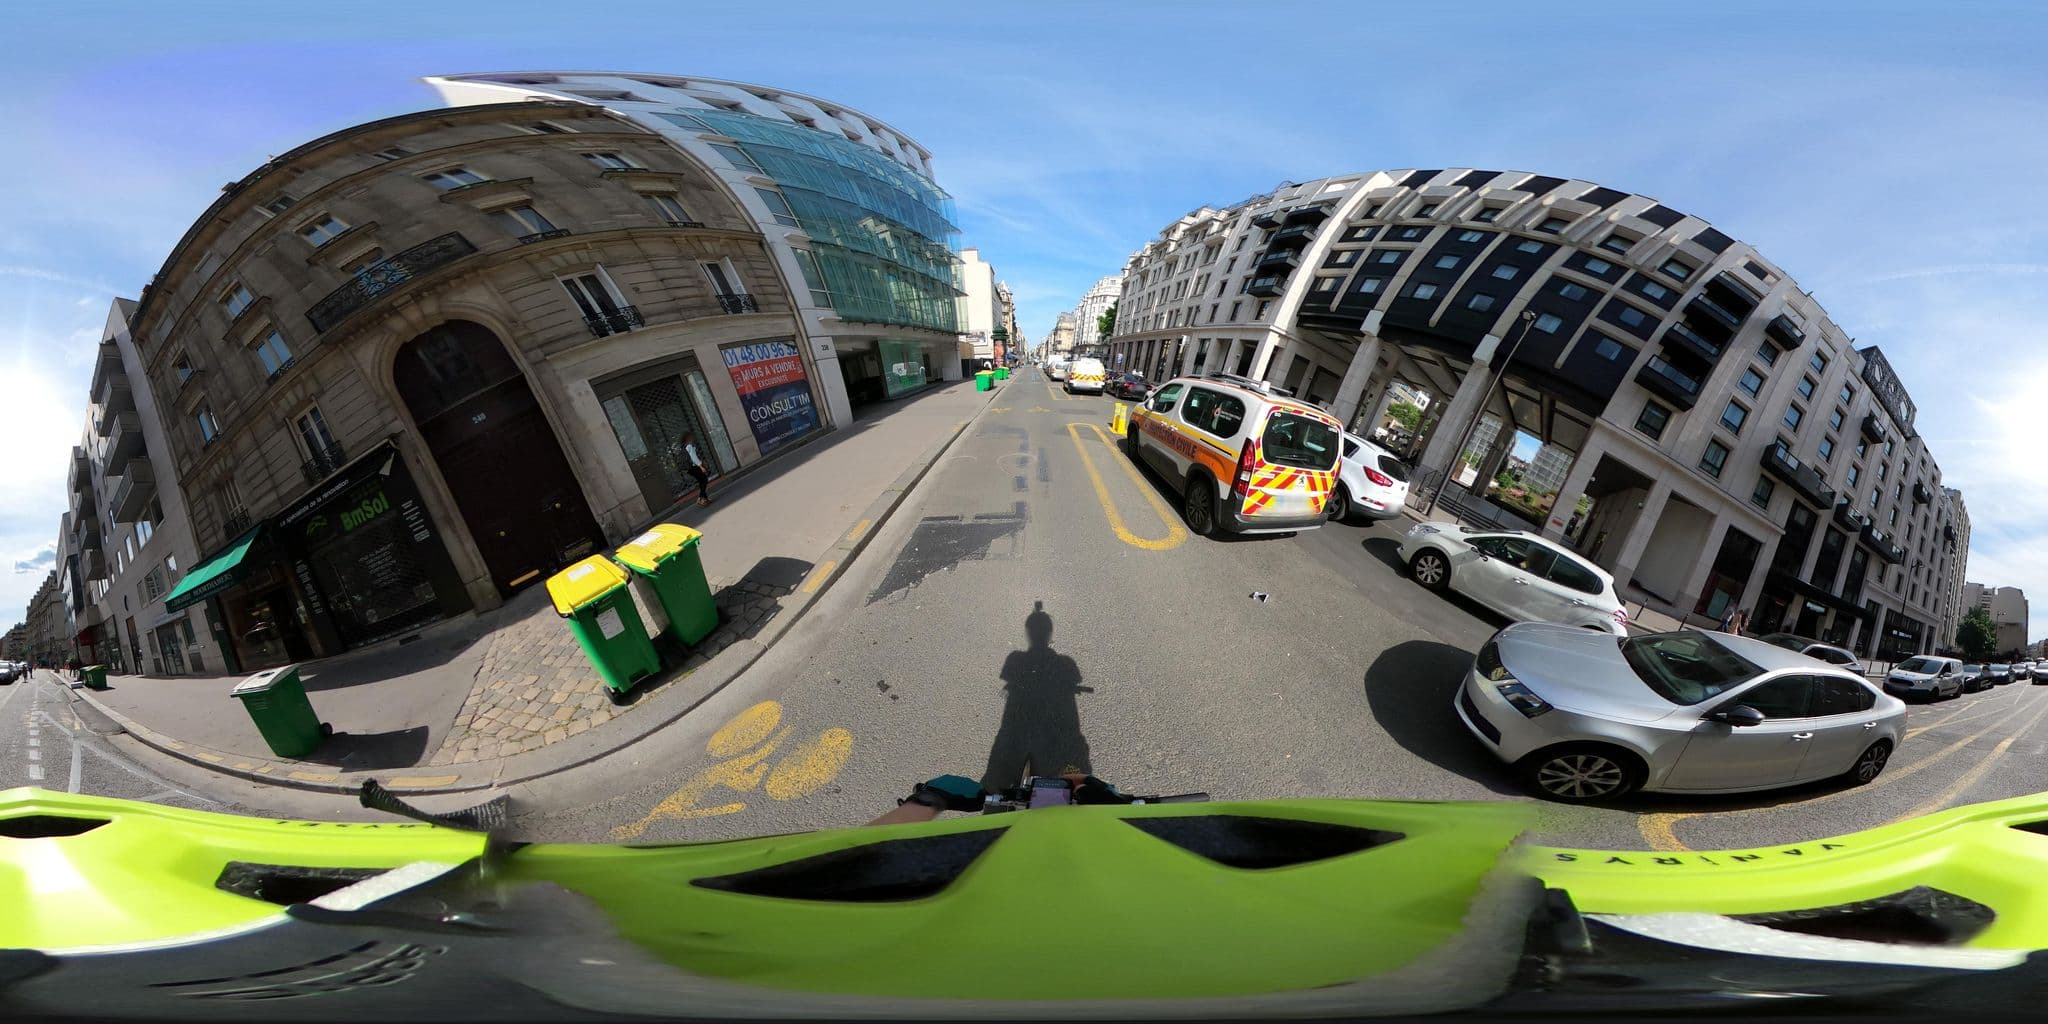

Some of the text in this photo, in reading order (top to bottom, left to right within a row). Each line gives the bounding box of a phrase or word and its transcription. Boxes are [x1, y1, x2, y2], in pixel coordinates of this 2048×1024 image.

[724, 350, 740, 366] 01
[741, 346, 756, 363] 48
[756, 344, 771, 360] 00
[771, 342, 785, 358] 96
[740, 360, 797, 382] MURS A VENDRE
[340, 491, 391, 532] BmSol
